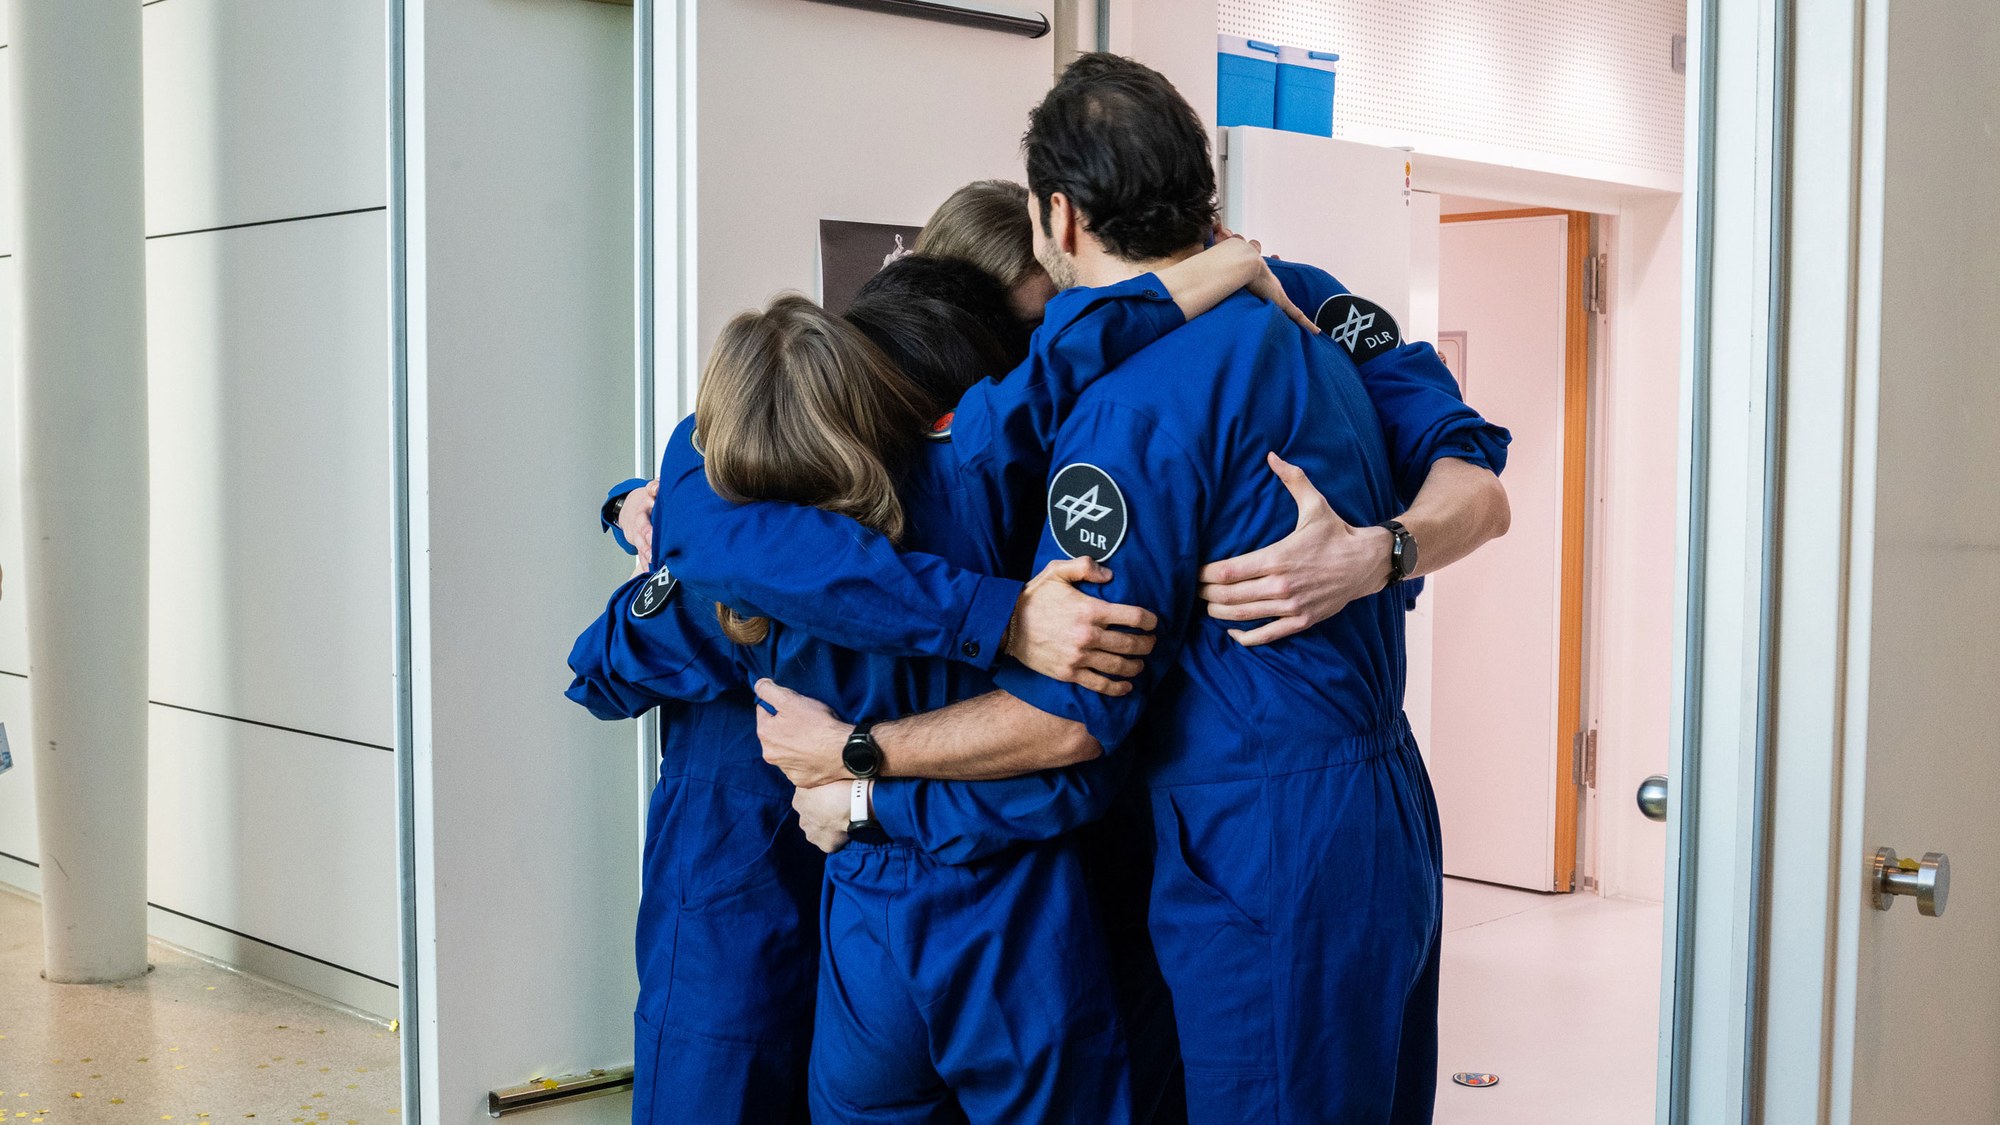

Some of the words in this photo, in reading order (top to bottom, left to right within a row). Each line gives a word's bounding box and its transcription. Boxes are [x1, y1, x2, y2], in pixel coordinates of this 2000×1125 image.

[1364, 331, 1394, 349] DLR
[1080, 528, 1107, 550] DLR
[644, 585, 654, 610] DLR
